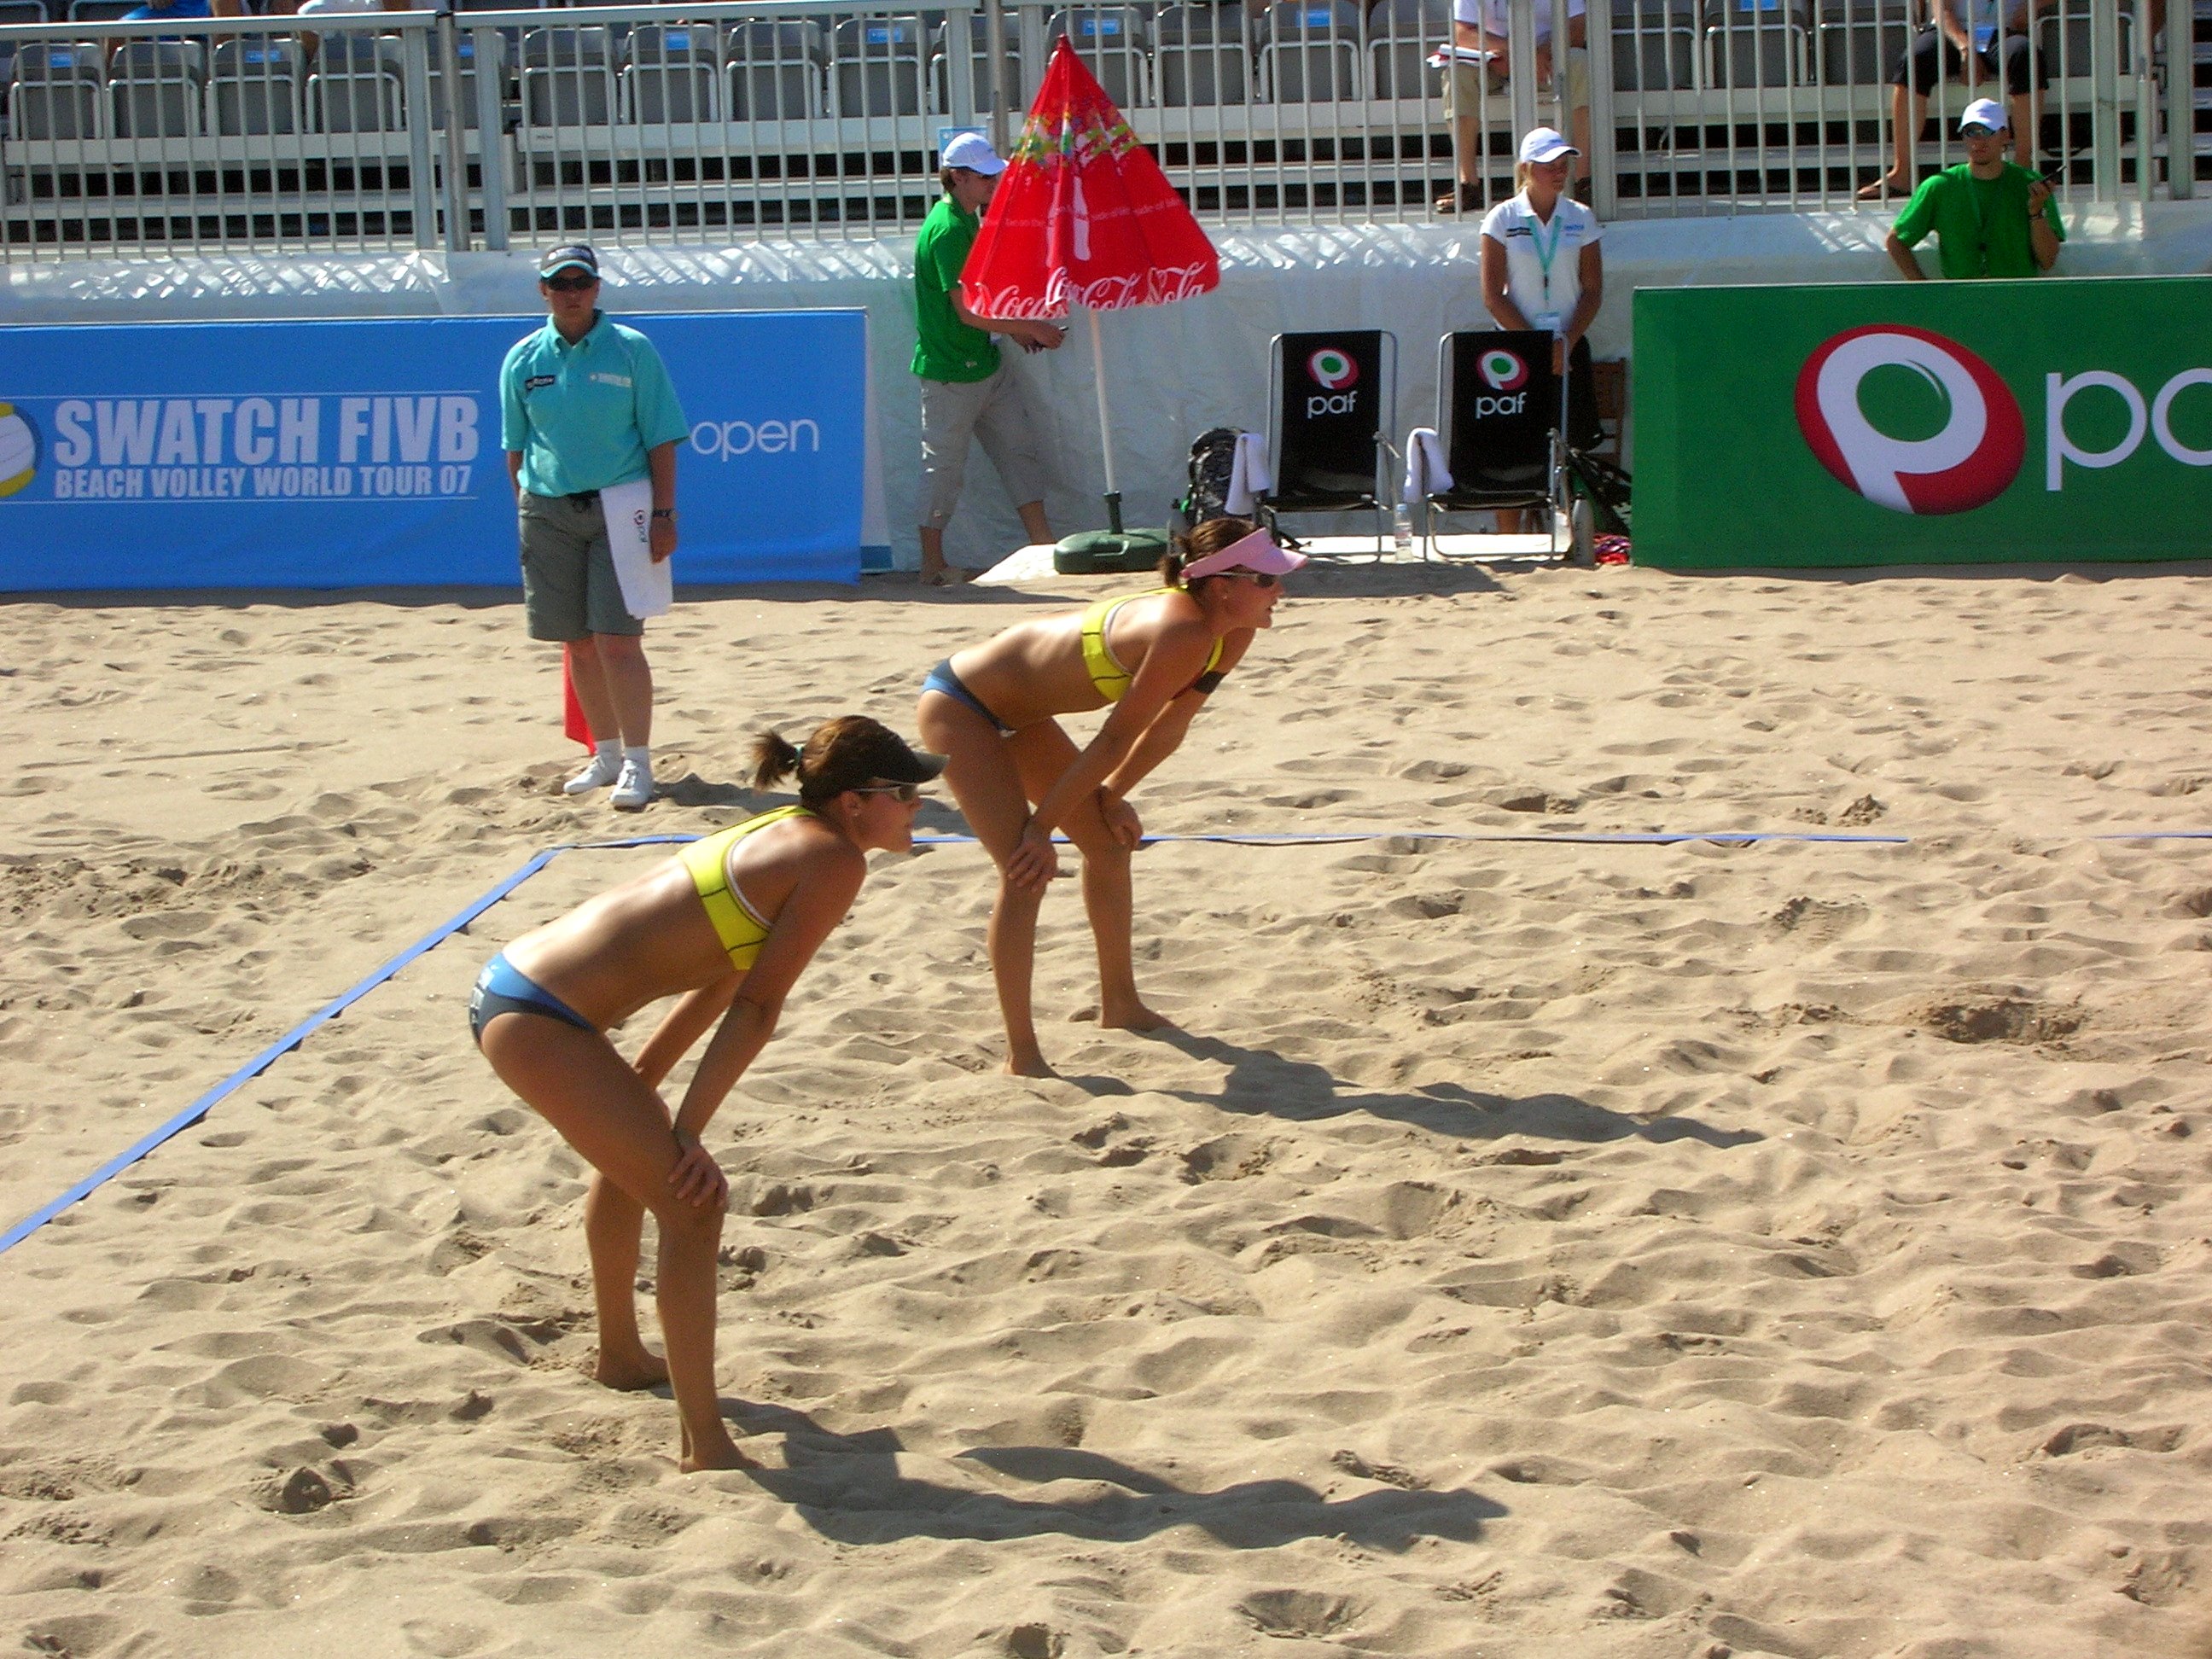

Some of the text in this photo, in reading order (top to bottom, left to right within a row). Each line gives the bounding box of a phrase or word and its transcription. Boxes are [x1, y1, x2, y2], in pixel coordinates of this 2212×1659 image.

[1307, 390, 1359, 420] paf
[1476, 391, 1528, 420] paf
[55, 396, 480, 468] SWATCH FIVB
[690, 418, 820, 463] open
[55, 465, 472, 499] BEACH VOLLEY WORLD TOUR 07
